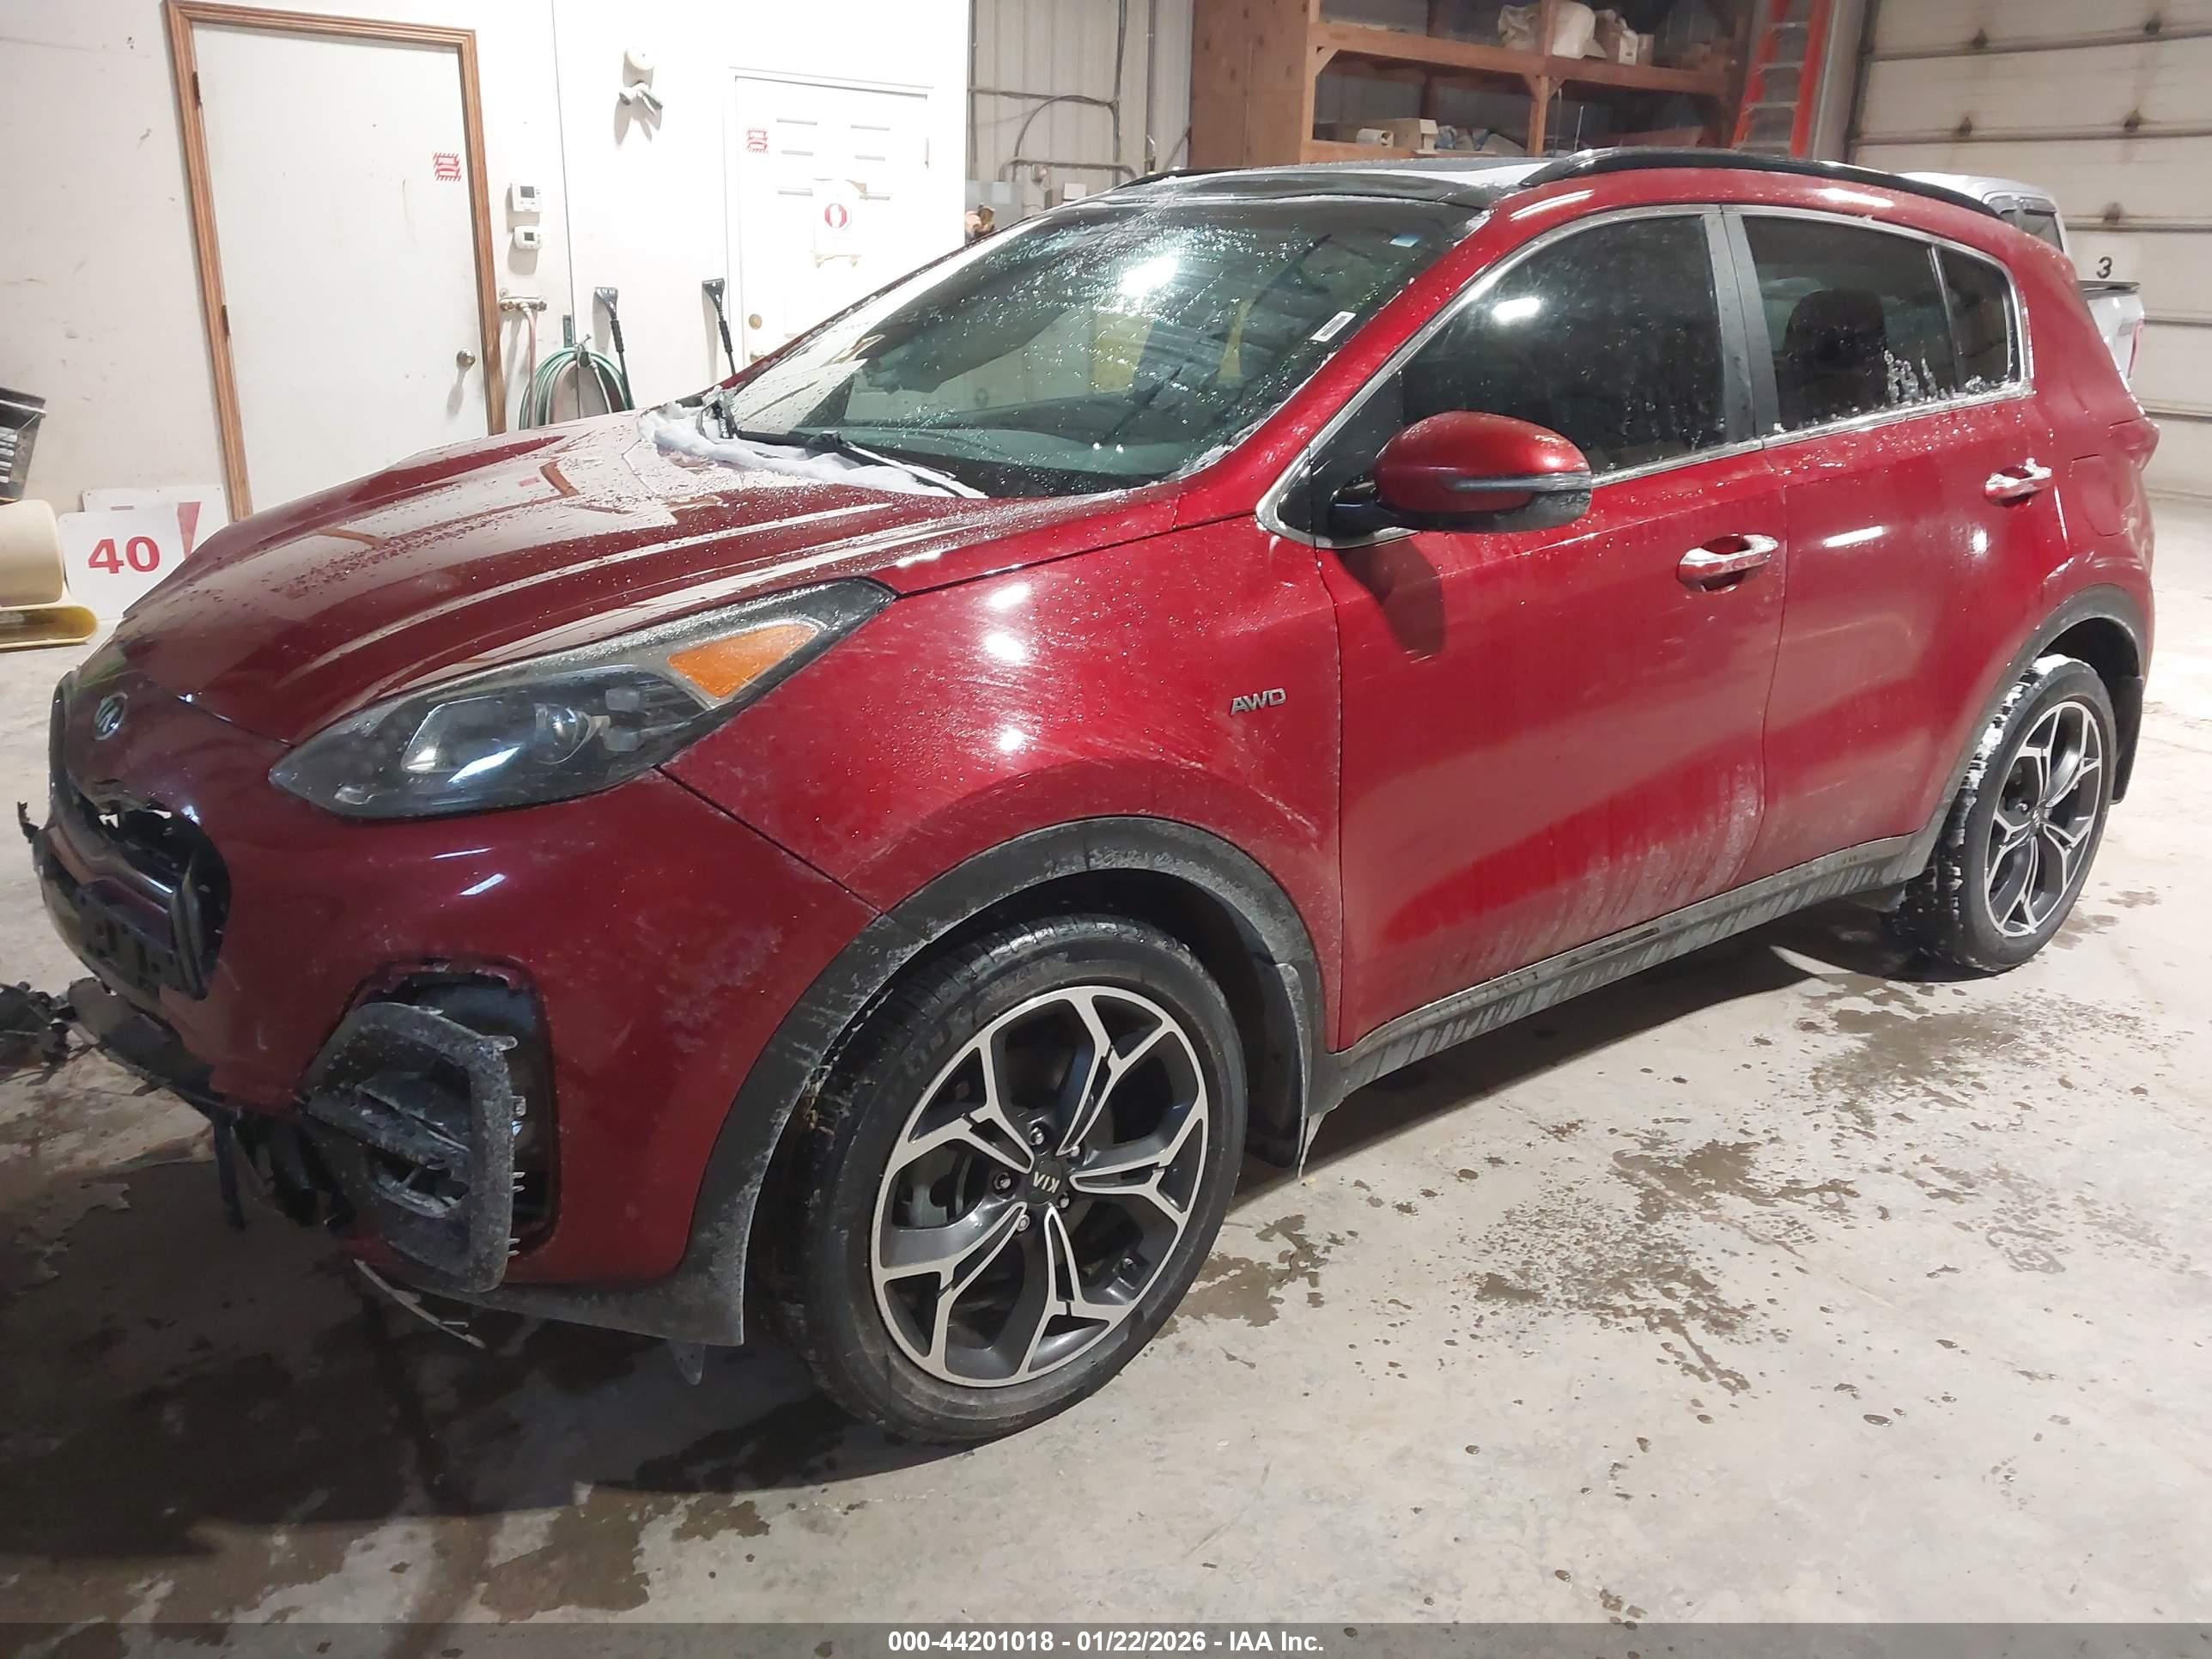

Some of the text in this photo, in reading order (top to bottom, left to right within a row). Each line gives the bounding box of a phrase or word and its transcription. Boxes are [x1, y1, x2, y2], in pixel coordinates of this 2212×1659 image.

[2096, 256, 2112, 279] 3
[88, 536, 160, 574] 40
[1229, 687, 1286, 716] AWD
[1033, 1170, 1060, 1194] KIA
